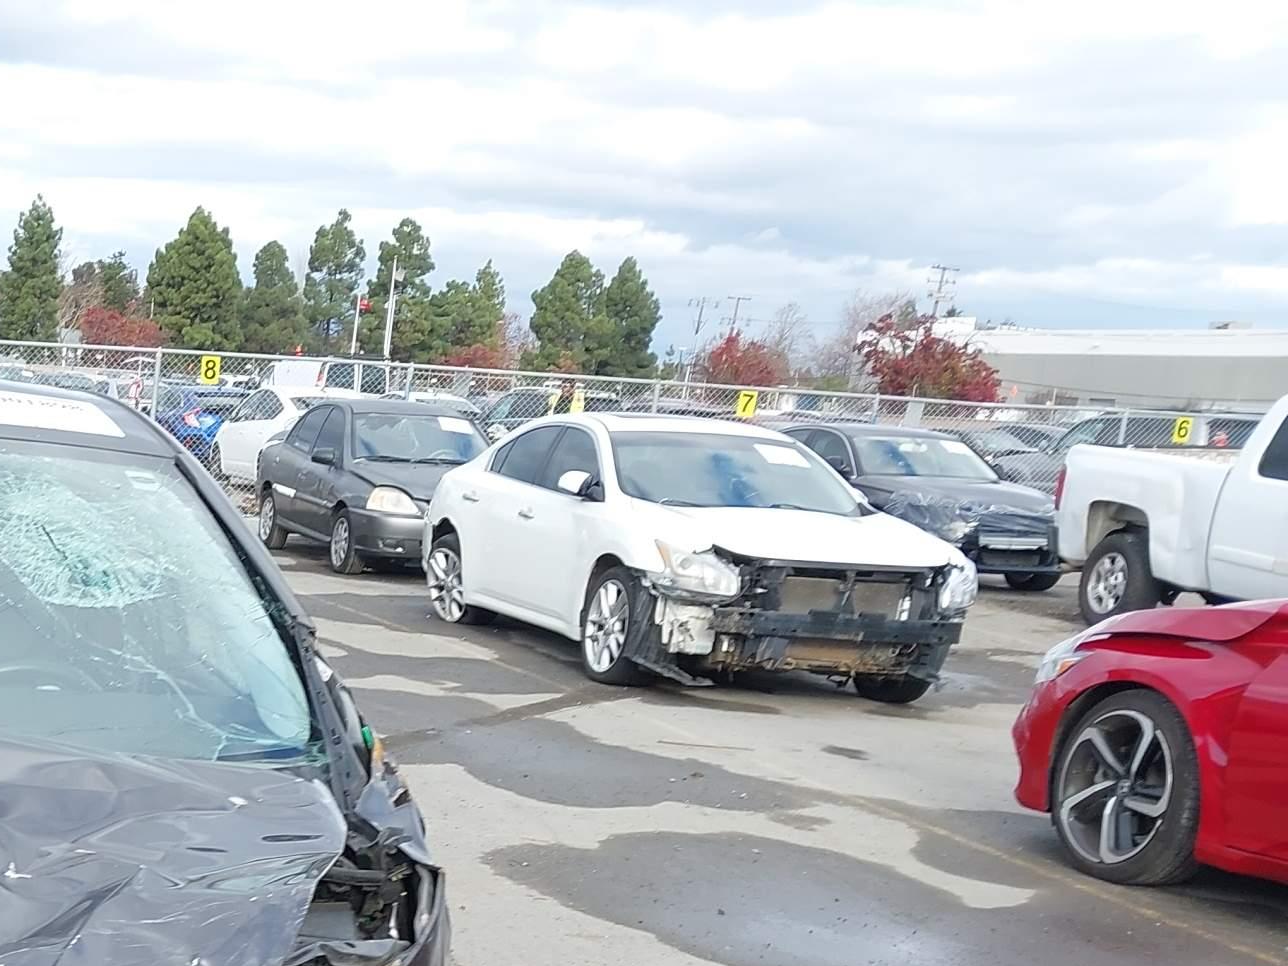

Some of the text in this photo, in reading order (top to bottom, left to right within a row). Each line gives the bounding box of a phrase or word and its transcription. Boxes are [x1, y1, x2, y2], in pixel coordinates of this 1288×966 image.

[204, 359, 216, 379] 8
[742, 393, 754, 412] 7
[1177, 420, 1190, 438] 6
